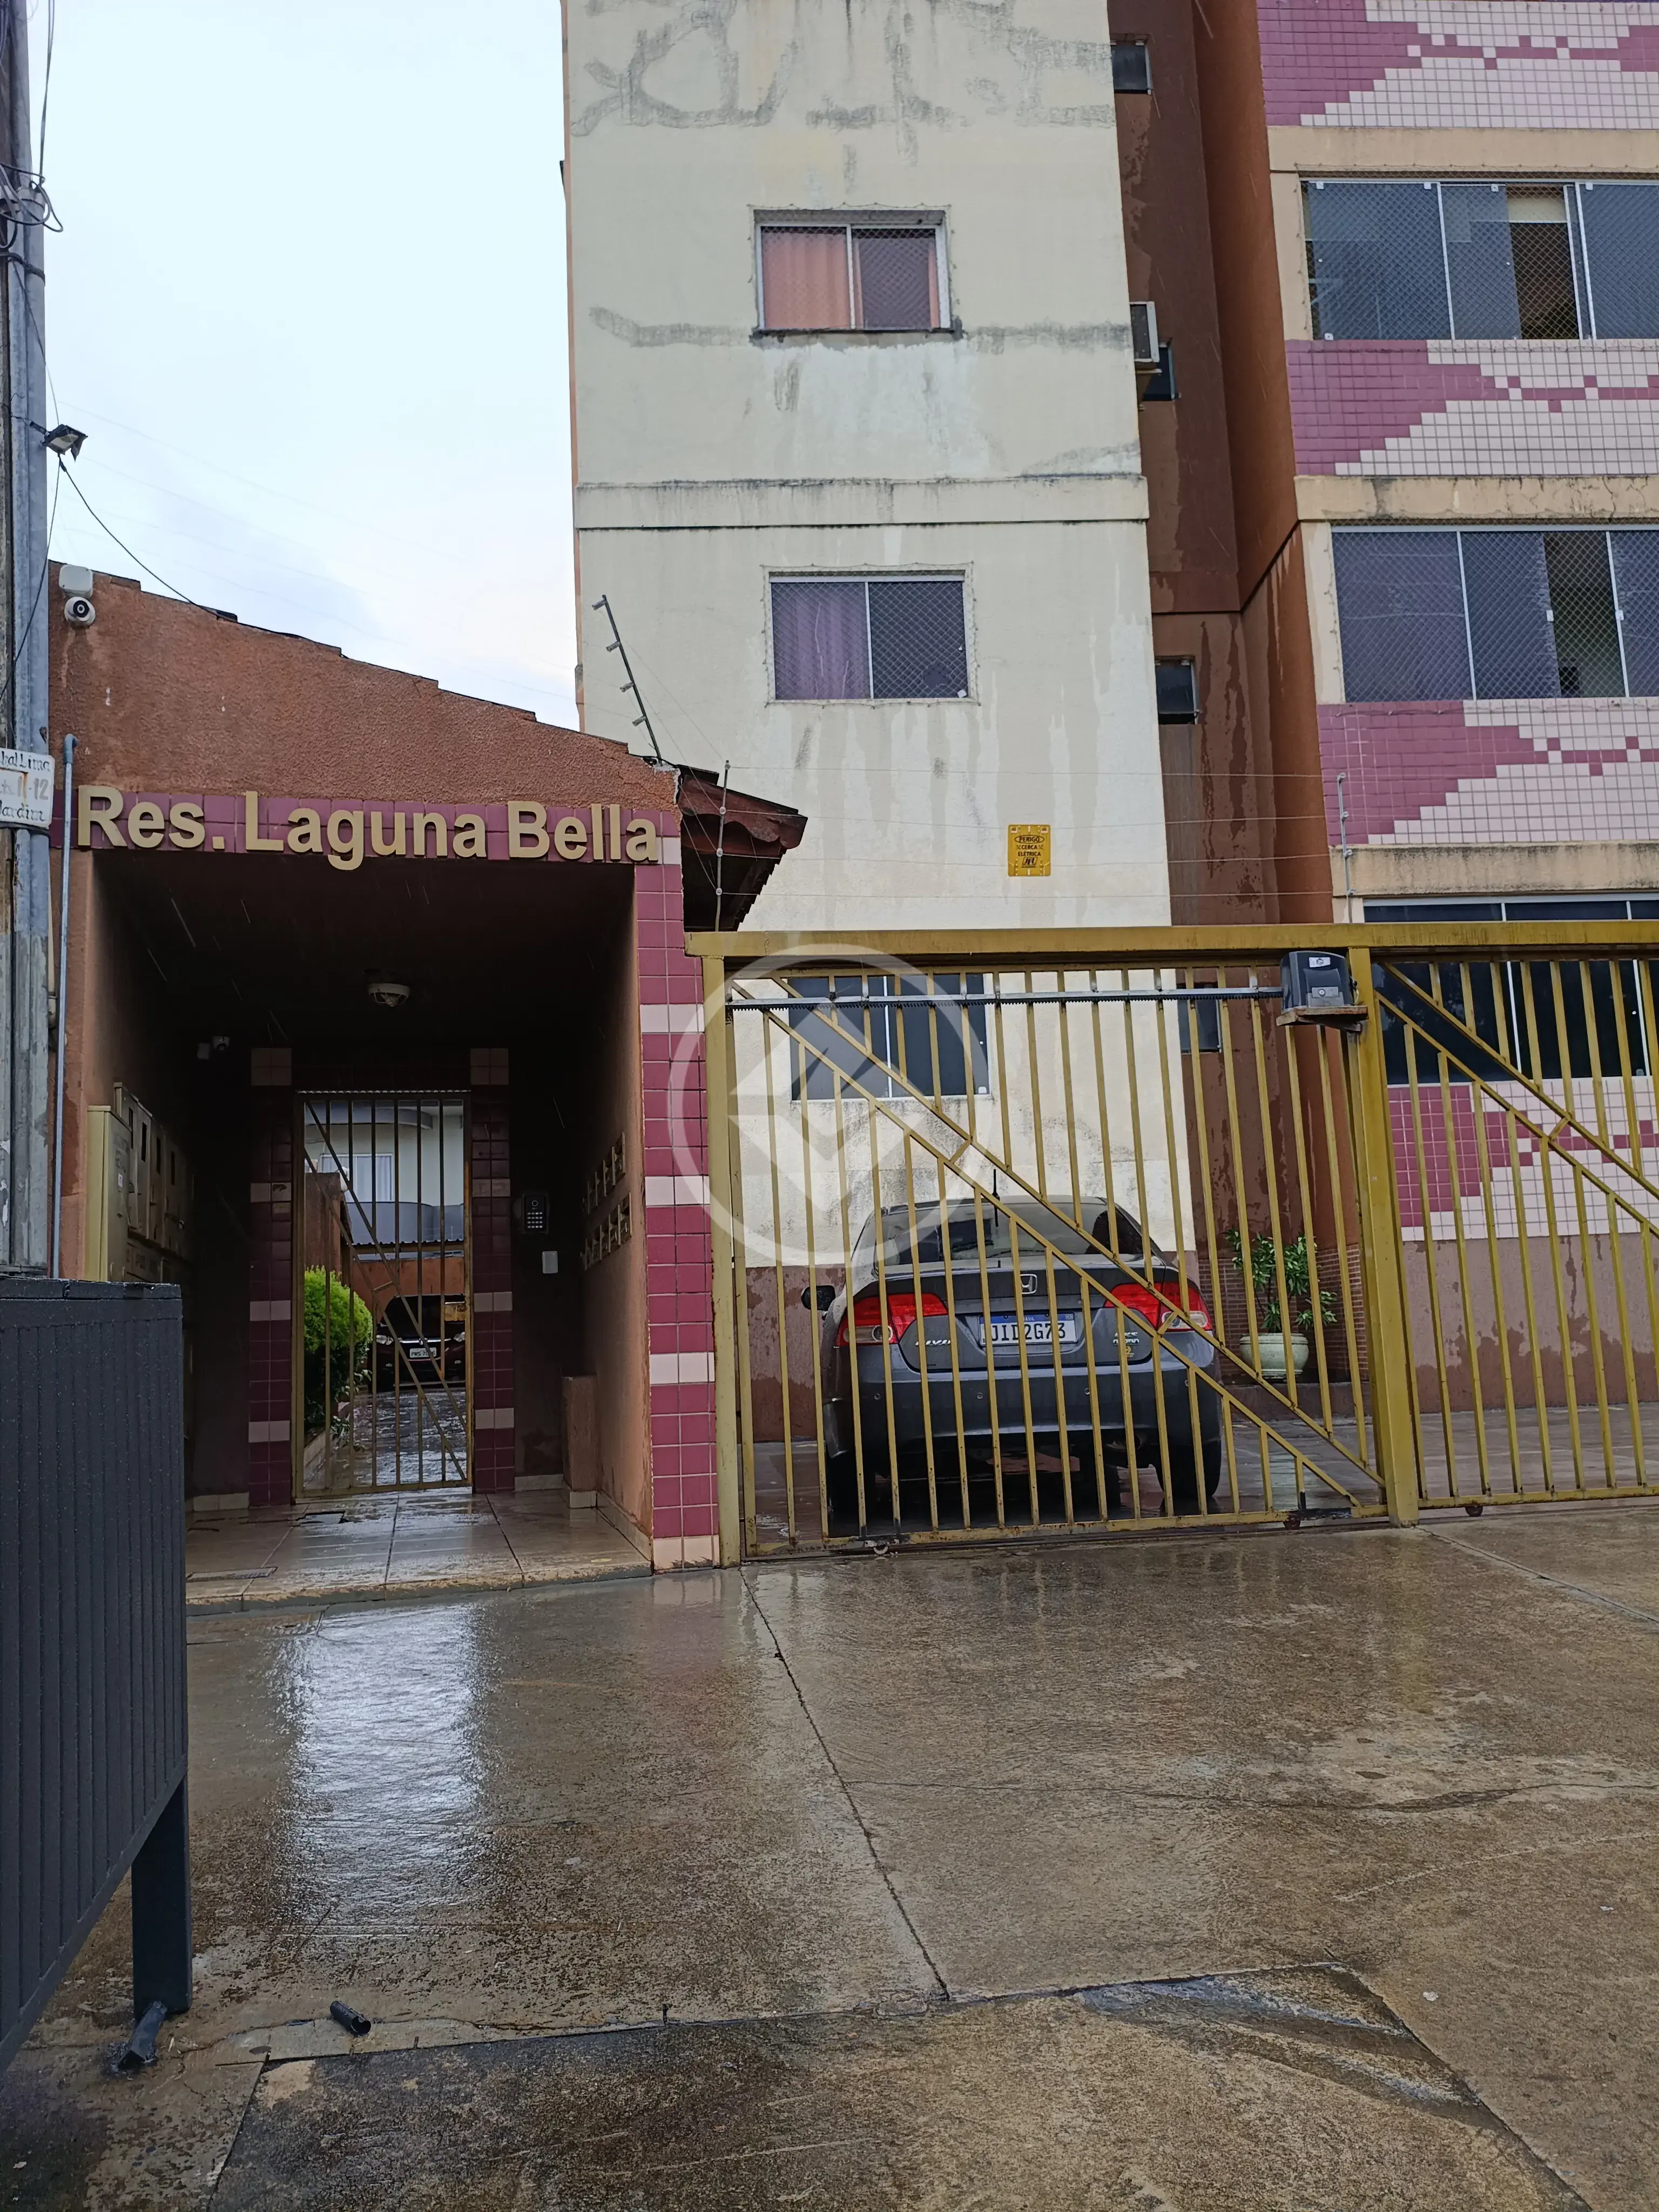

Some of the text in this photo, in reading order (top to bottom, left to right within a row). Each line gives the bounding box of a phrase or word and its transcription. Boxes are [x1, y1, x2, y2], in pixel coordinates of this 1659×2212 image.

[19, 753, 50, 772] Lima
[78, 785, 658, 871] Res. Laguna Bella
